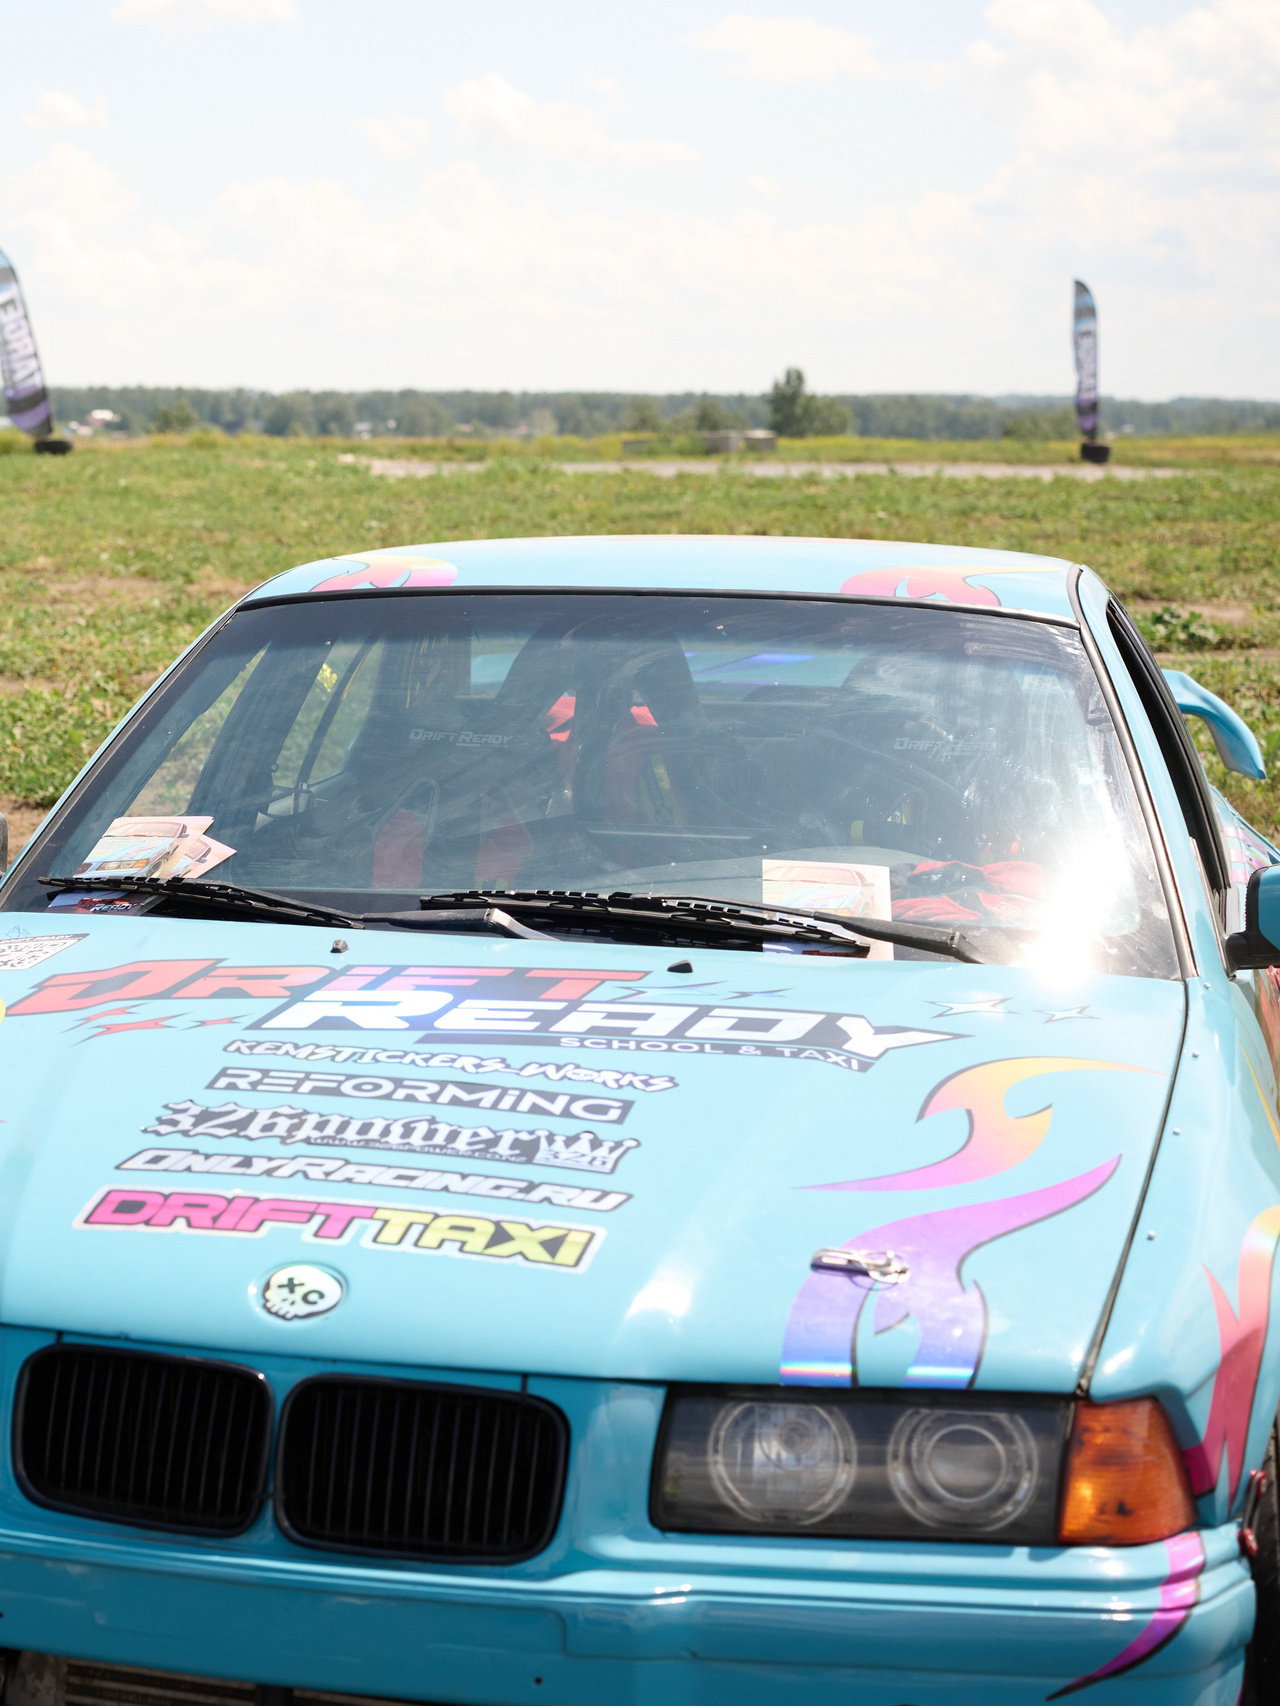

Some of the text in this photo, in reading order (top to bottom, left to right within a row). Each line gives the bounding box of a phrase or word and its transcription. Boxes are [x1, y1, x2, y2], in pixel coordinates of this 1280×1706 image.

[409, 728, 513, 744] DRIFT READY
[6, 958, 652, 1016] DRIFT
[261, 989, 956, 1058] READY
[559, 1036, 860, 1071] SCHOOL & TAXI
